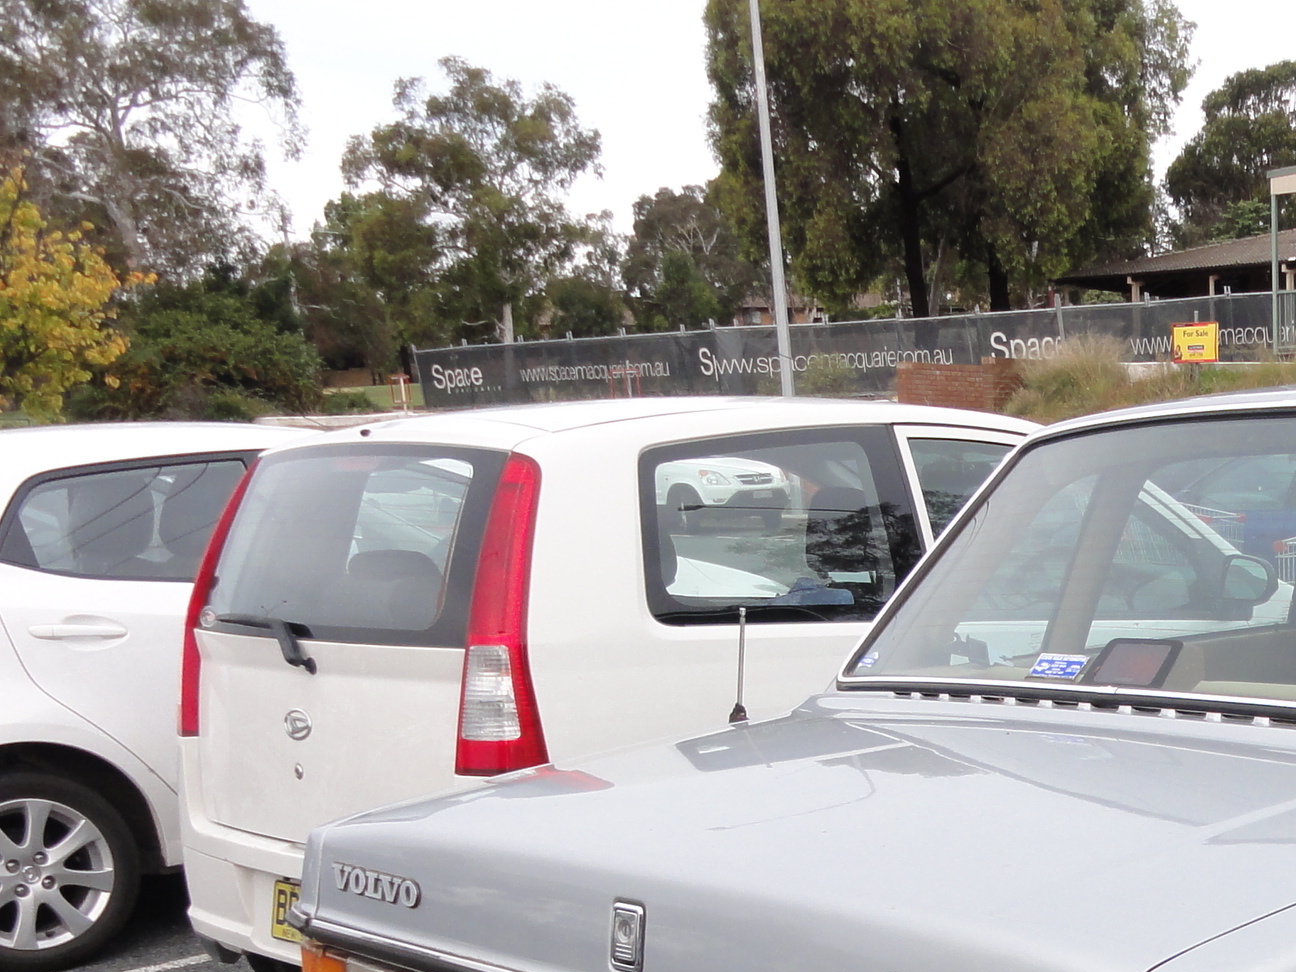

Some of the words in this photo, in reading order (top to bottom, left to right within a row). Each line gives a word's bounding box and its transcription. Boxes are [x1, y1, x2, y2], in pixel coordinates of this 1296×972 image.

[990, 331, 1063, 361] Spac
[1182, 330, 1194, 338] For
[1195, 329, 1209, 337] Sale
[431, 363, 484, 394] Space
[331, 861, 422, 909] VOLVO
